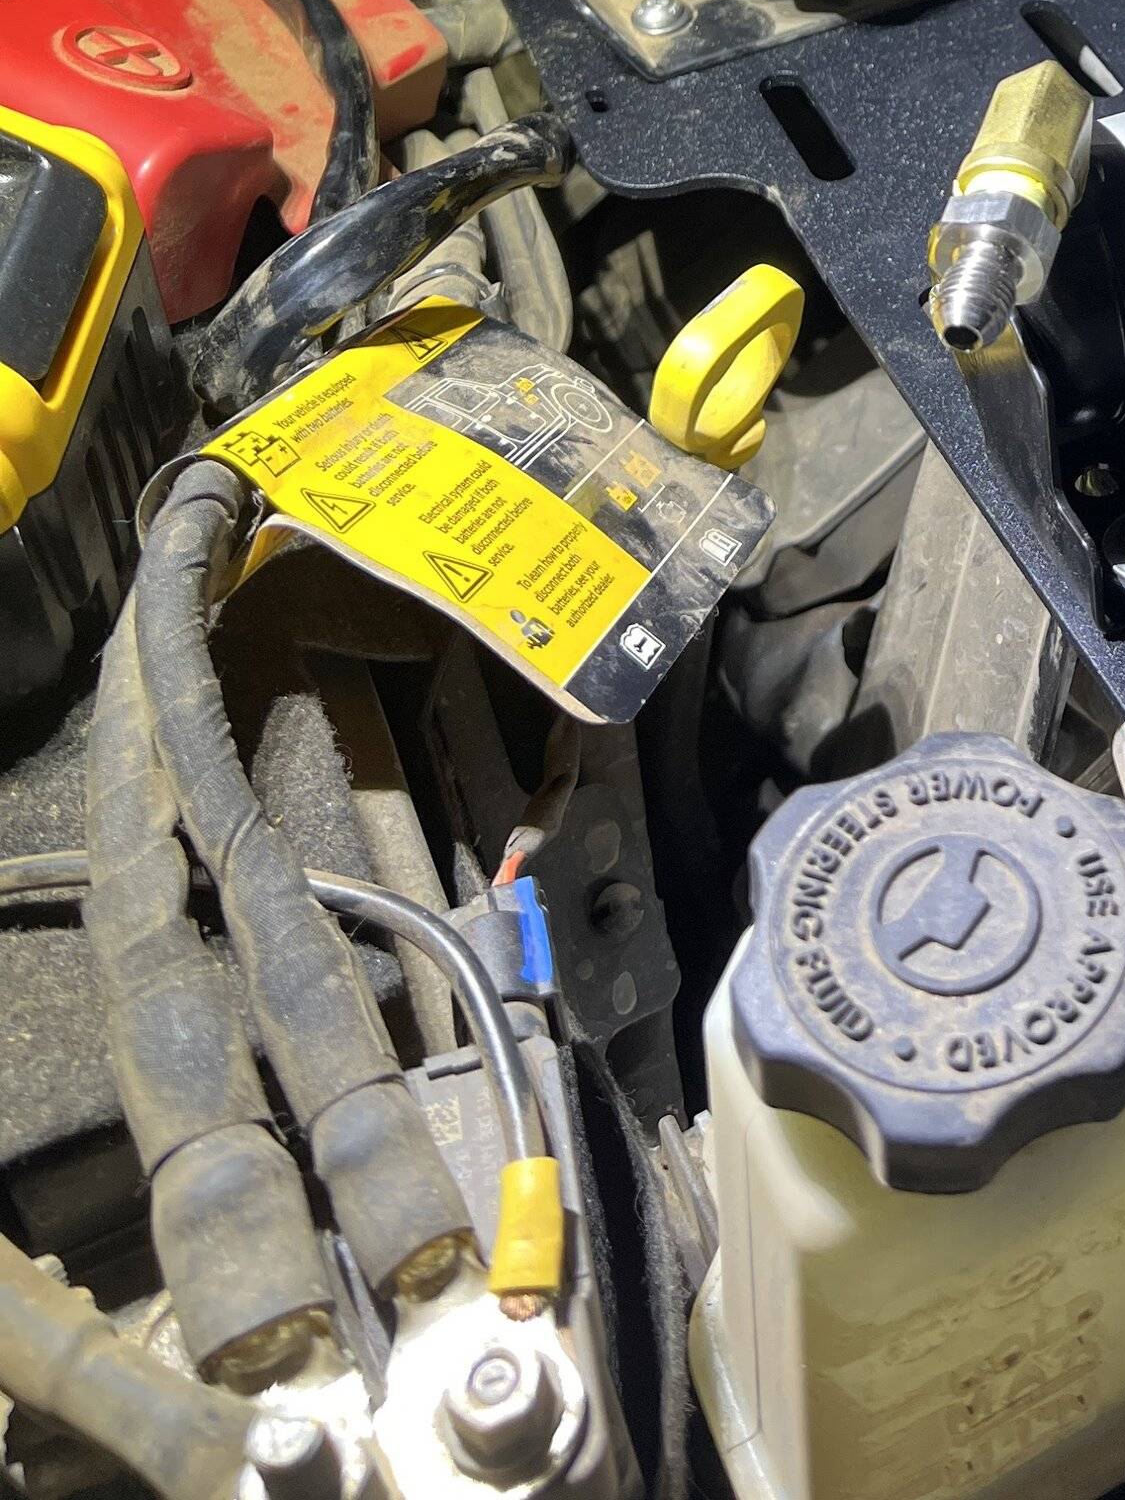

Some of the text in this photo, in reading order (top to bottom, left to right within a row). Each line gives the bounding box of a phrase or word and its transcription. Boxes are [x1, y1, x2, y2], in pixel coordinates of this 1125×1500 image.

[290, 396, 320, 418] vehicle
[312, 393, 325, 403] is
[320, 373, 356, 398] equipped
[289, 427, 311, 443] with
[305, 418, 324, 432] two
[315, 448, 347, 471] Serious
[339, 433, 368, 451] injury
[361, 426, 374, 436] or
[333, 461, 358, 480] could
[353, 445, 377, 464] result
[347, 441, 409, 488] batteries are not
[368, 439, 438, 497] disconnected before
[385, 481, 416, 506] service.
[417, 459, 492, 524] Electrical system could
[434, 478, 500, 534] be damaged if both
[451, 496, 506, 544] batteries are not
[470, 496, 533, 554] disconnected before
[487, 542, 515, 566] service.
[516, 521, 588, 590] To learn how to properly
[534, 552, 582, 602] disconnect both
[546, 559, 600, 615] batteries, see your
[565, 572, 615, 628] authorized dealer.
[790, 772, 1046, 1043] POWER STEERING FLUID
[945, 850, 1120, 1073] USE APPROVED
